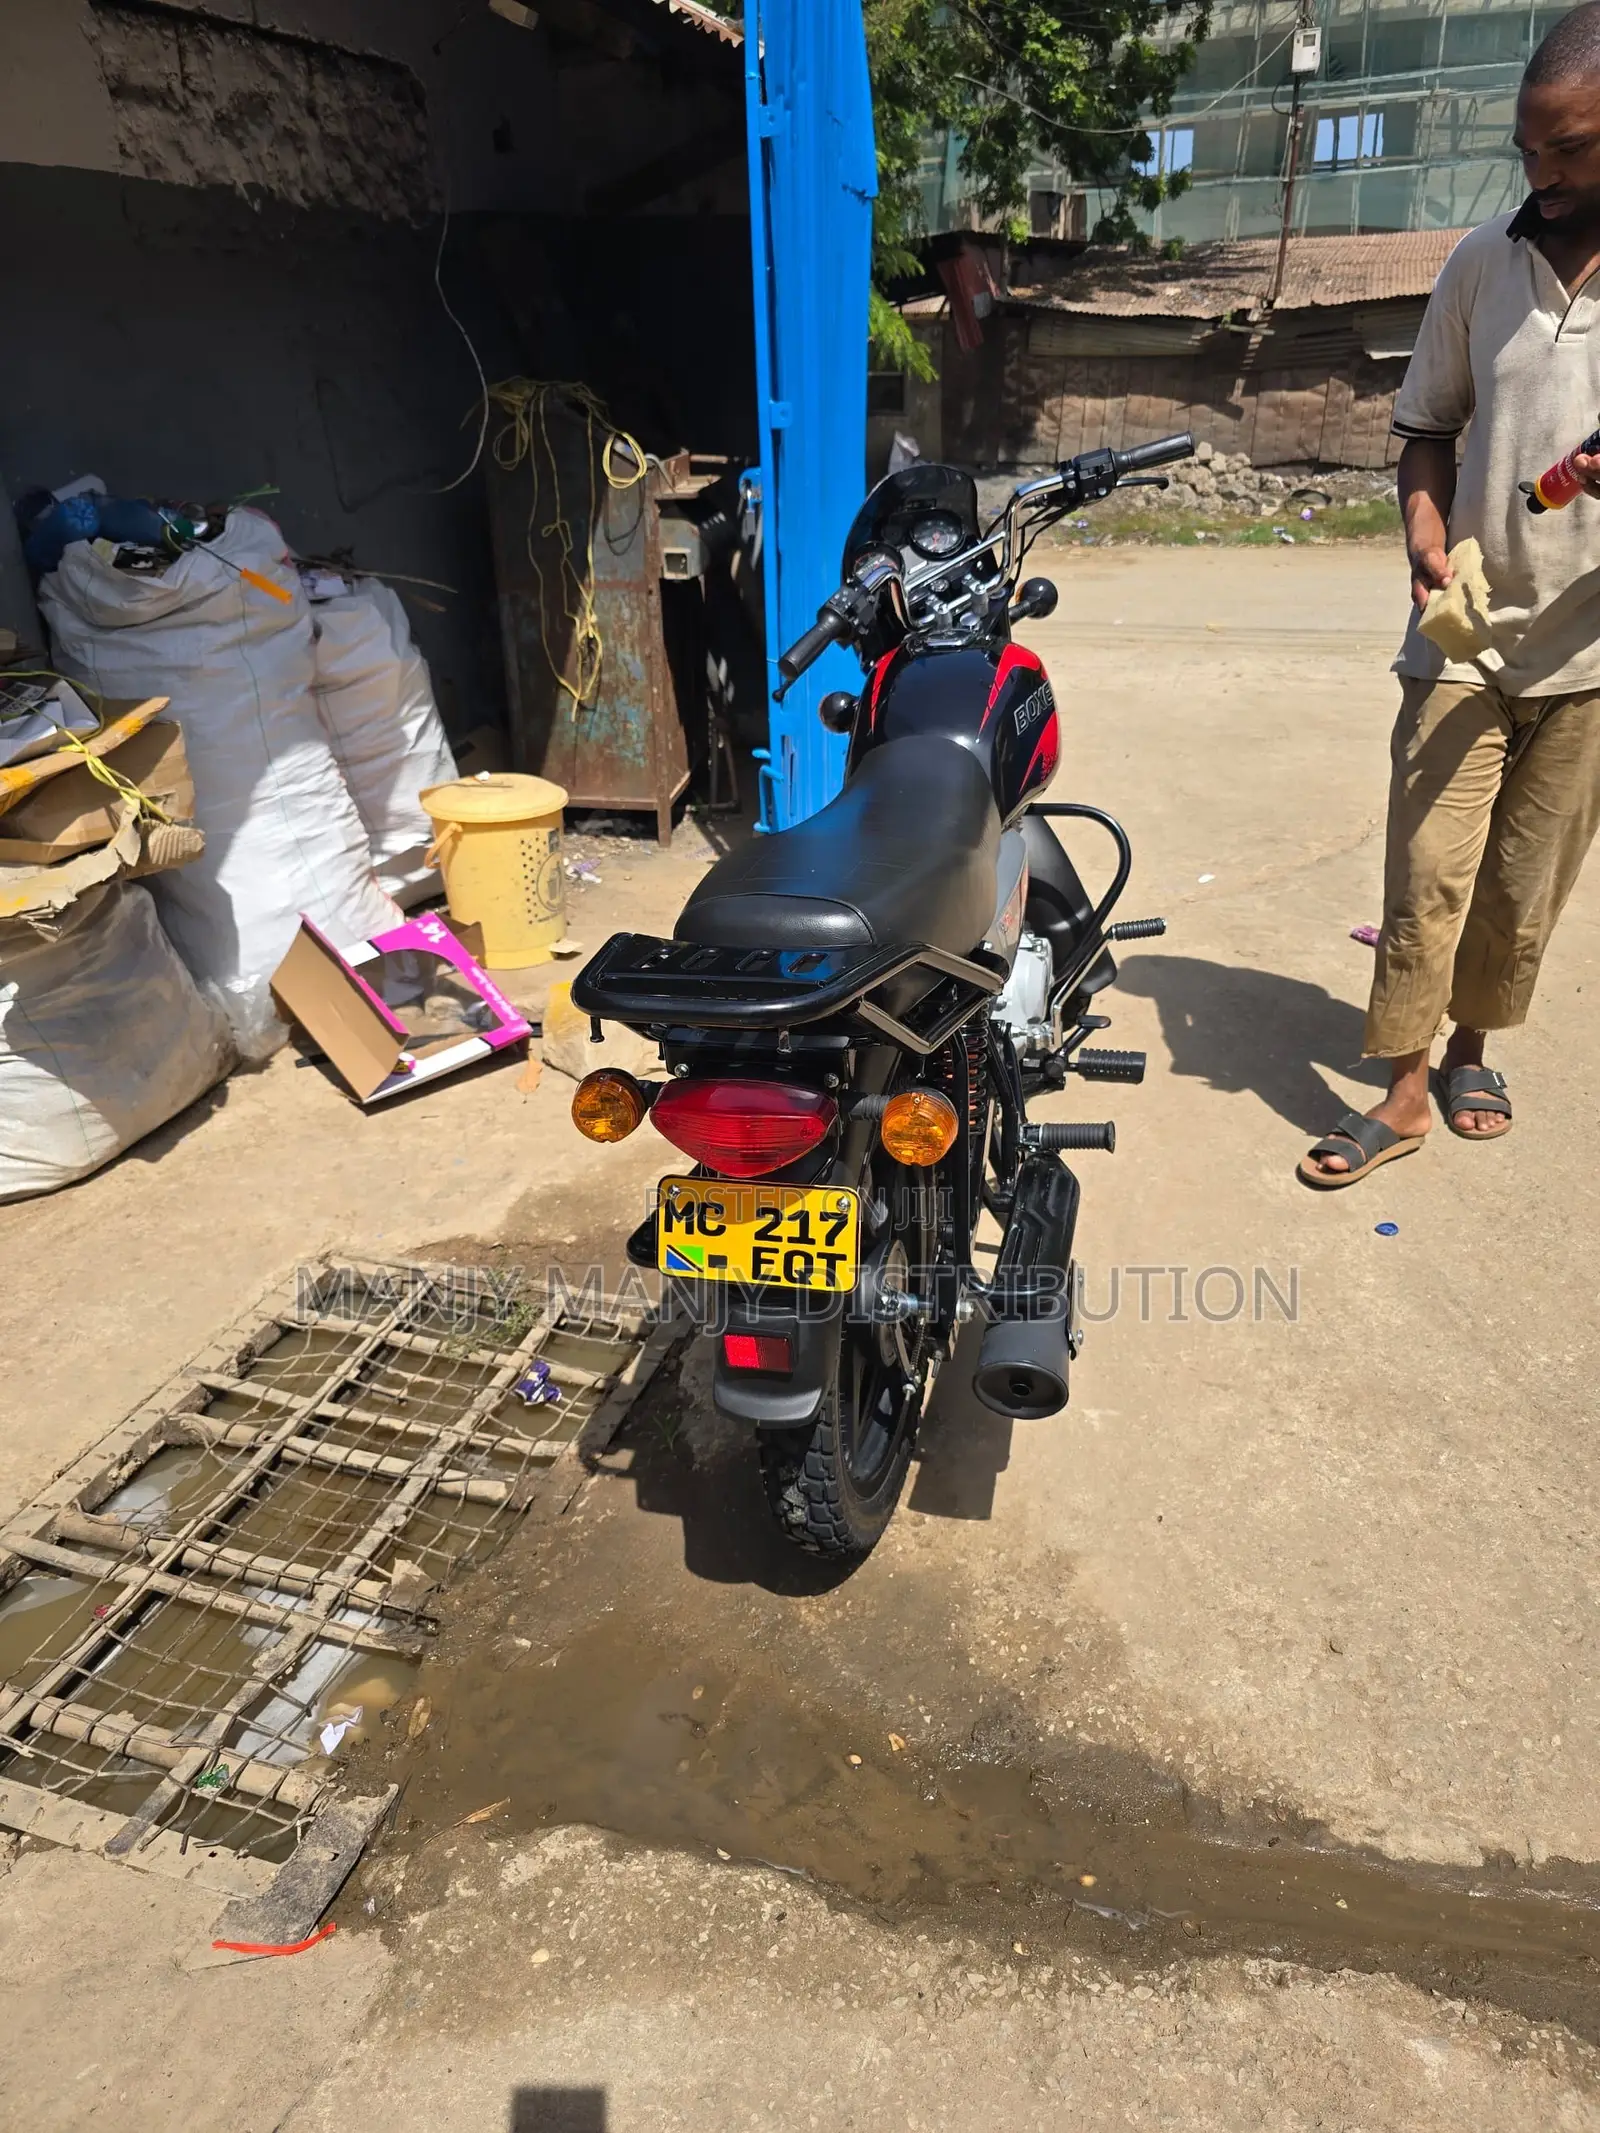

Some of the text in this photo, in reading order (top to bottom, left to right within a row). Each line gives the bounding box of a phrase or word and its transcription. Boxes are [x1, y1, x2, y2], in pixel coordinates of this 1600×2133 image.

[664, 1198, 849, 1247] MC 217
[752, 1246, 848, 1288] EQT
